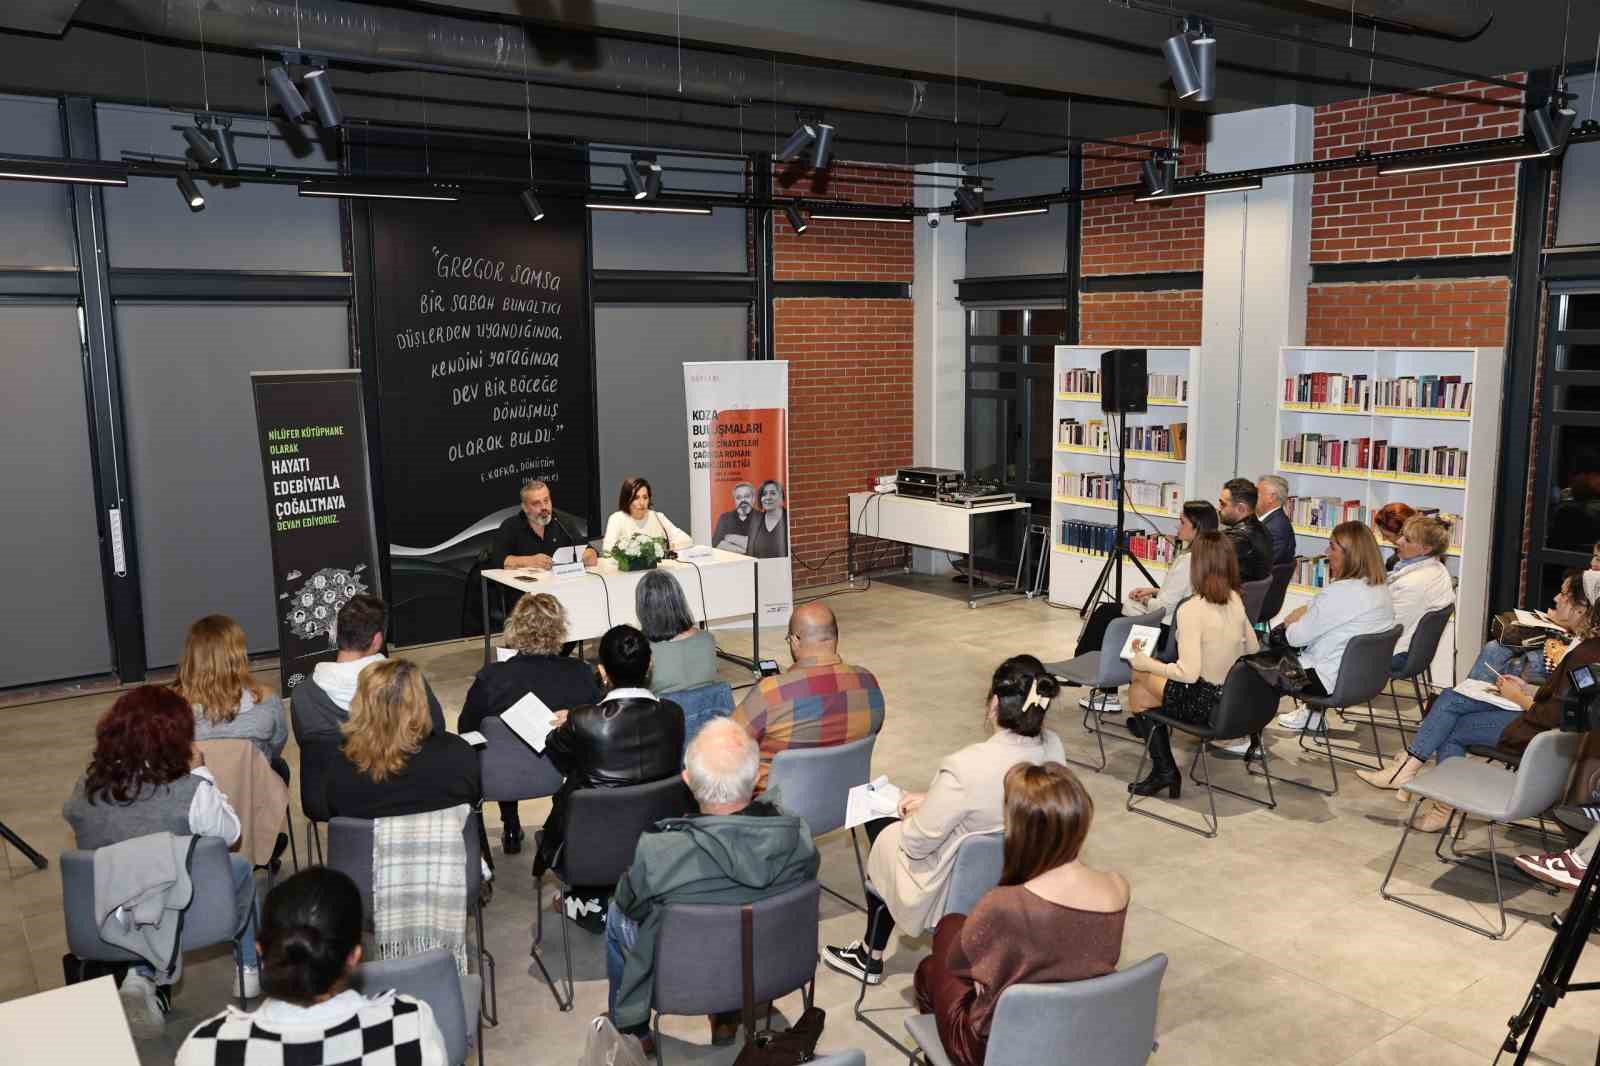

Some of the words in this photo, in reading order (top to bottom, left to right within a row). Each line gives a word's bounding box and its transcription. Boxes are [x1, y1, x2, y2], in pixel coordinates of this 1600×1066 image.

[511, 264, 561, 291] SAMSA
[420, 290, 445, 314] BİR
[451, 294, 495, 312] SABAH
[503, 297, 561, 315] BUNALTICI
[396, 324, 471, 349] DÜŞLERDEN
[431, 350, 483, 378] KENDİNİ
[488, 347, 559, 367] YATAĞINDA
[452, 383, 479, 406] DEV
[485, 377, 507, 397] BİR
[510, 375, 559, 393] BÖCEĞE
[493, 400, 559, 421] DÖNÜŞMÜŞ
[692, 409, 720, 421] KOZA
[268, 428, 300, 441] NİLÜFER
[301, 425, 344, 438] KÜTÜPHANE
[269, 443, 299, 455] OLARAK
[448, 434, 504, 462] OLARAK
[271, 457, 310, 475] HAYATI
[273, 475, 340, 496] EDEBİYATLA
[275, 494, 346, 520] ÇOĞALTMAYA
[277, 519, 301, 531] DEVAM
